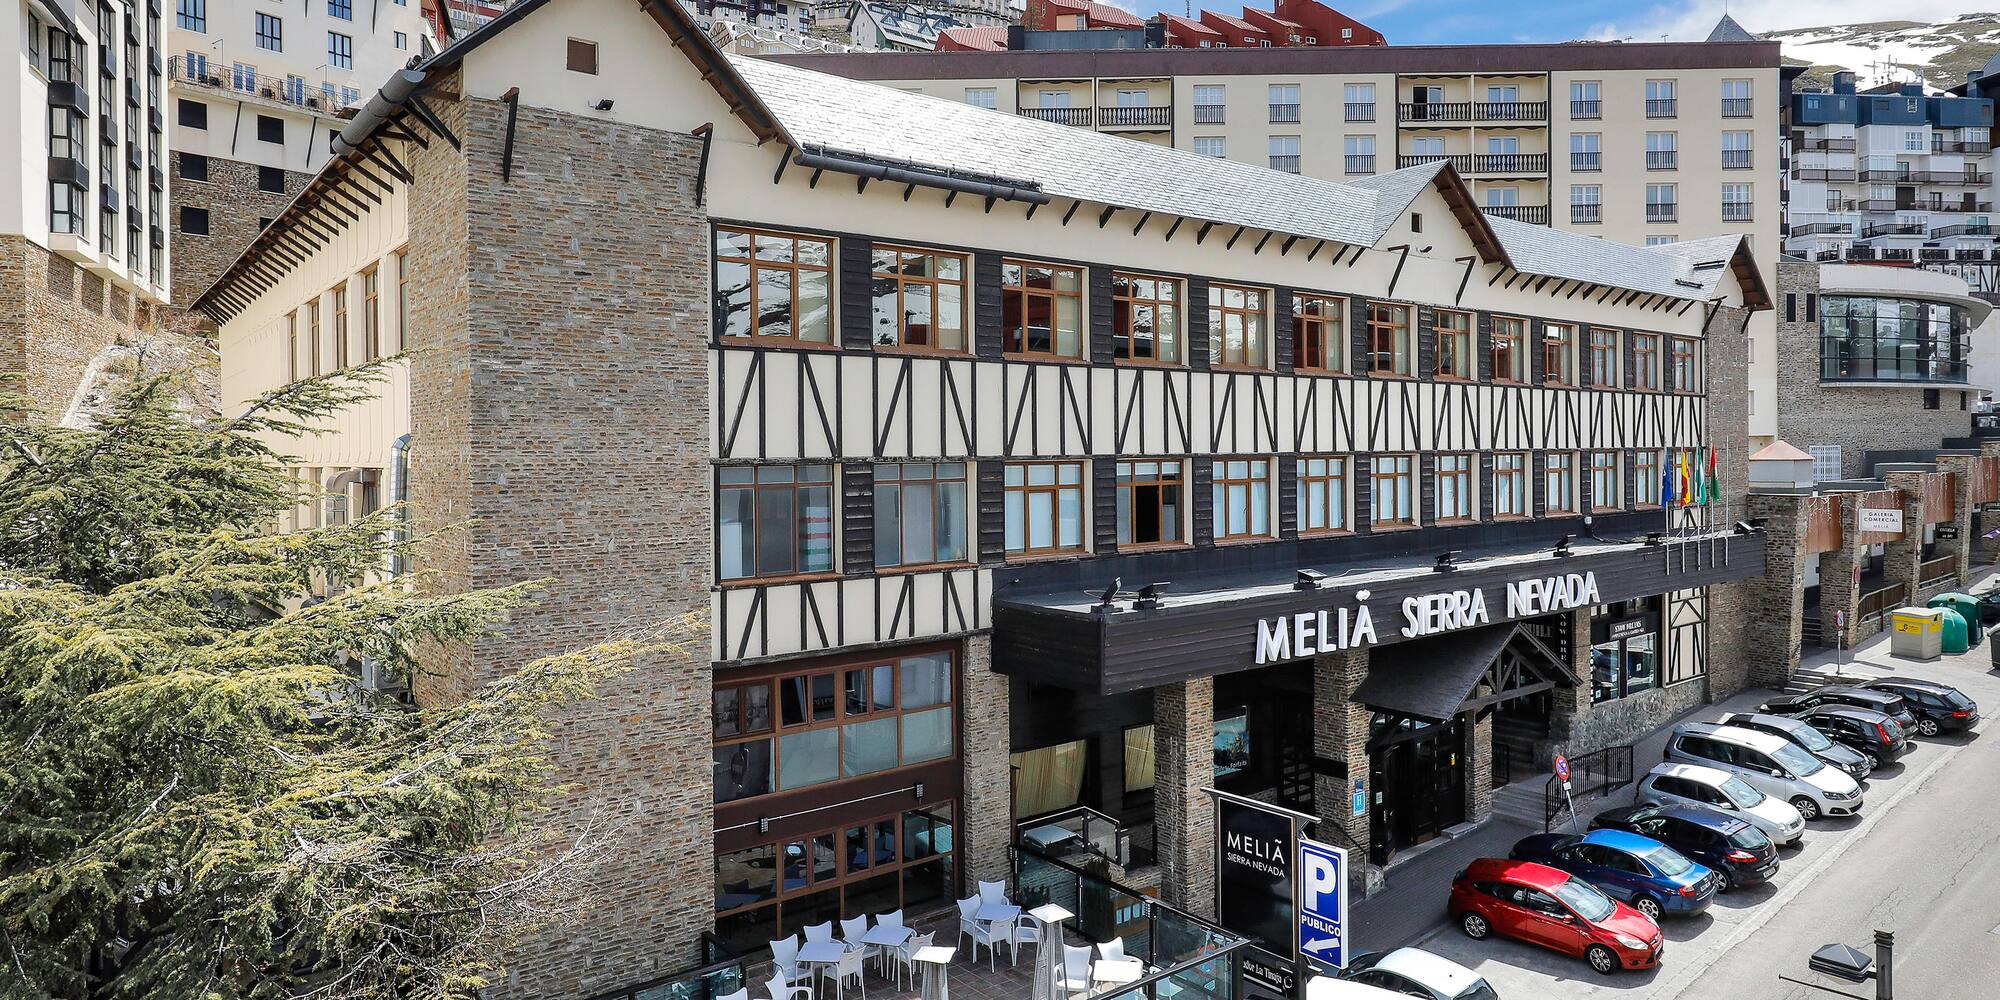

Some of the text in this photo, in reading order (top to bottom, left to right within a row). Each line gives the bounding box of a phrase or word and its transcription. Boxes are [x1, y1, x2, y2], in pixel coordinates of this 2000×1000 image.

[1401, 588, 1490, 639] SIERRA
[1506, 571, 1601, 619] NEVADA
[1227, 851, 1286, 878] SIERRA NEVADA
[1304, 851, 1337, 912] P
[1301, 914, 1341, 937] PUBLICO
[1255, 964, 1264, 976] La
[1264, 967, 1282, 984] Tinaja
